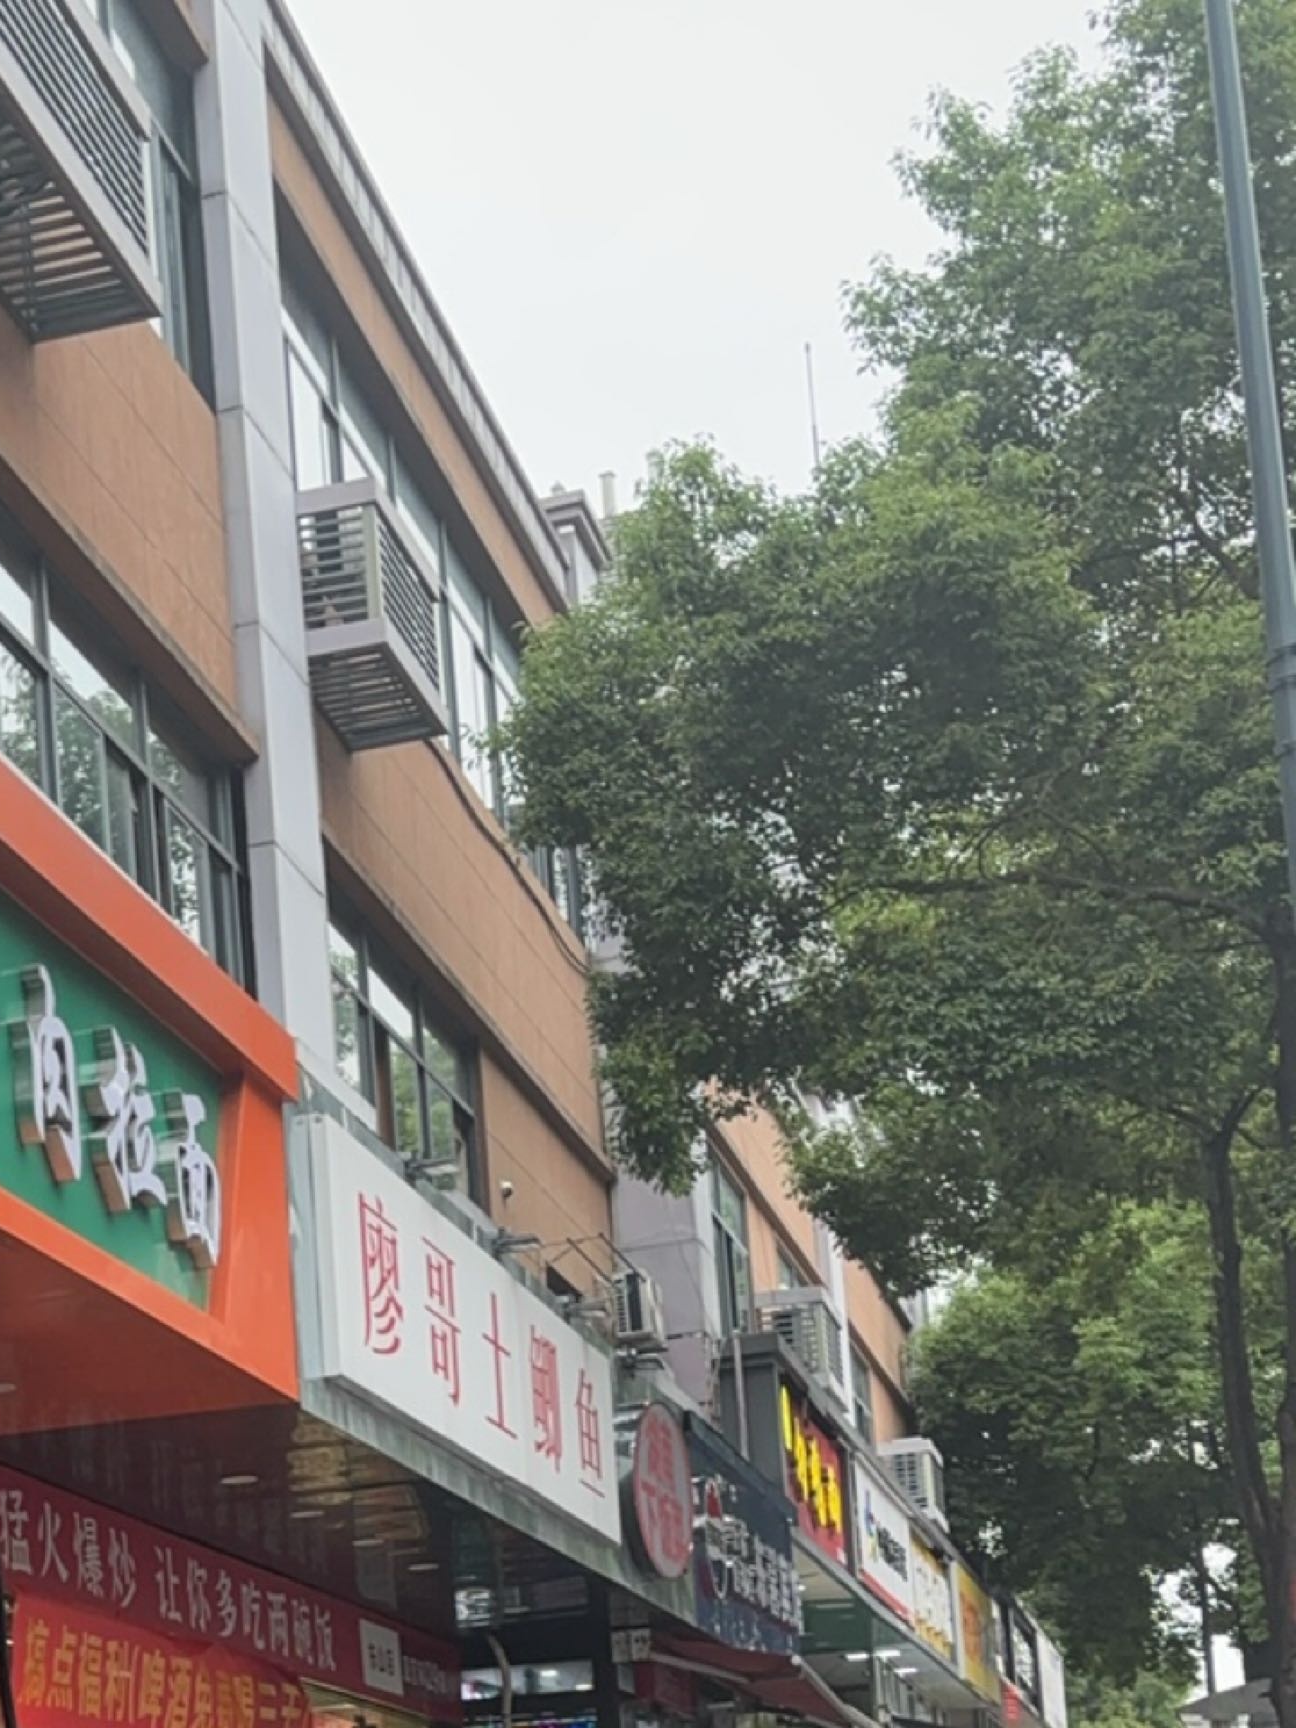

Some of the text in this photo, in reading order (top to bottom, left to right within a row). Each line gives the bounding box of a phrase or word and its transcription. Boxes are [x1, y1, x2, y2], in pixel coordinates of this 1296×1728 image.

[155, 1545, 337, 1672] 让你多吃两碗饭
